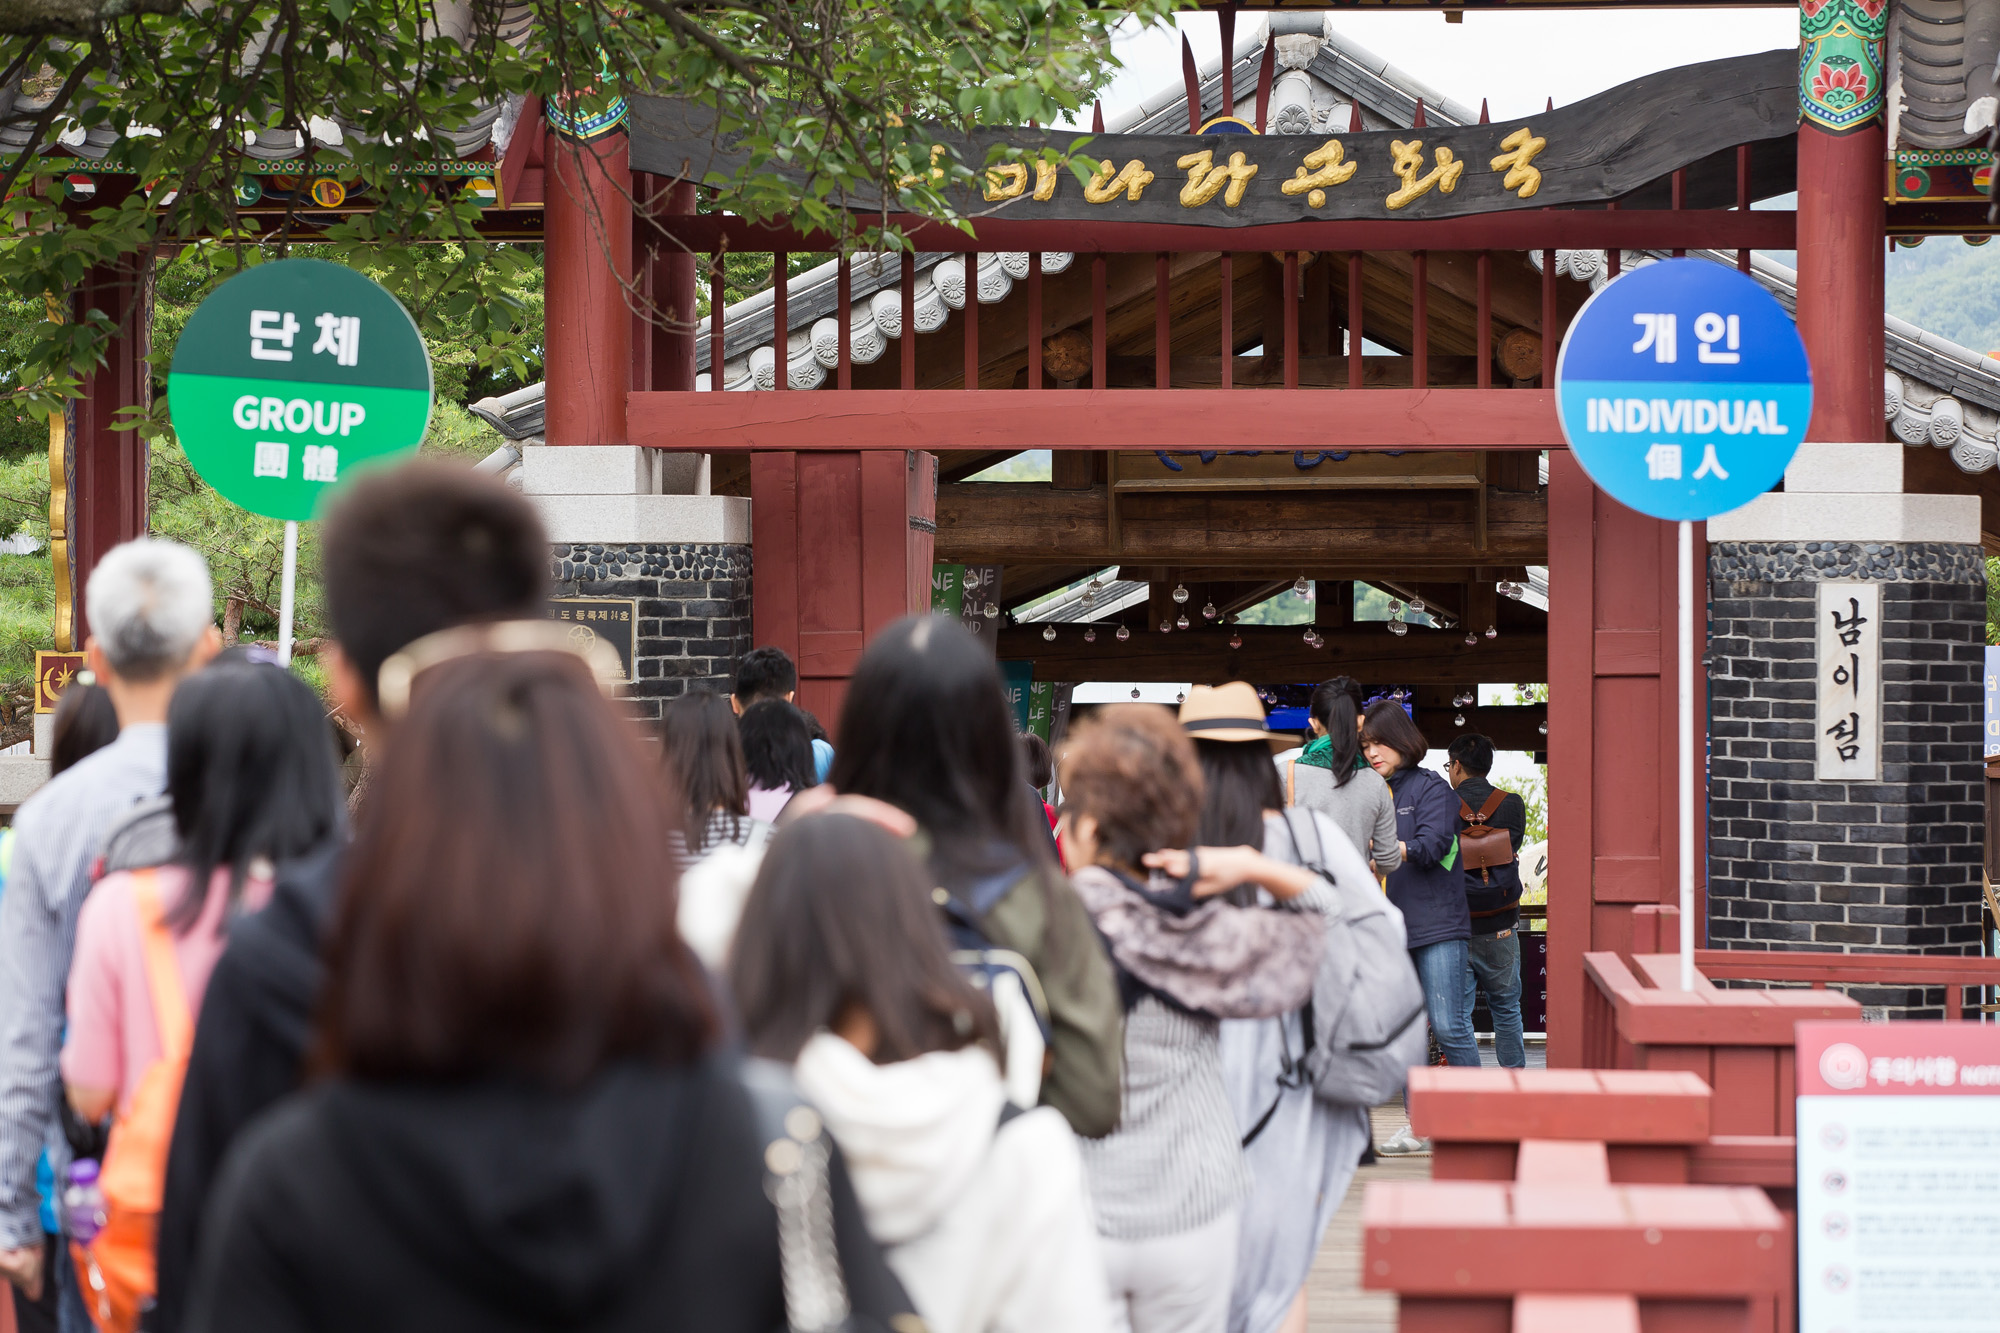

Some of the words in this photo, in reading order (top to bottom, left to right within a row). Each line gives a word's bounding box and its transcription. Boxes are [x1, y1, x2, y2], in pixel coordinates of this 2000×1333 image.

[249, 309, 361, 367] 단체
[1632, 312, 1741, 365] 개인
[232, 394, 366, 437] GROUP
[1587, 397, 1790, 435] INDIVIDUAL
[1644, 442, 1730, 481] 個人
[1825, 596, 1868, 762] 남이섬
